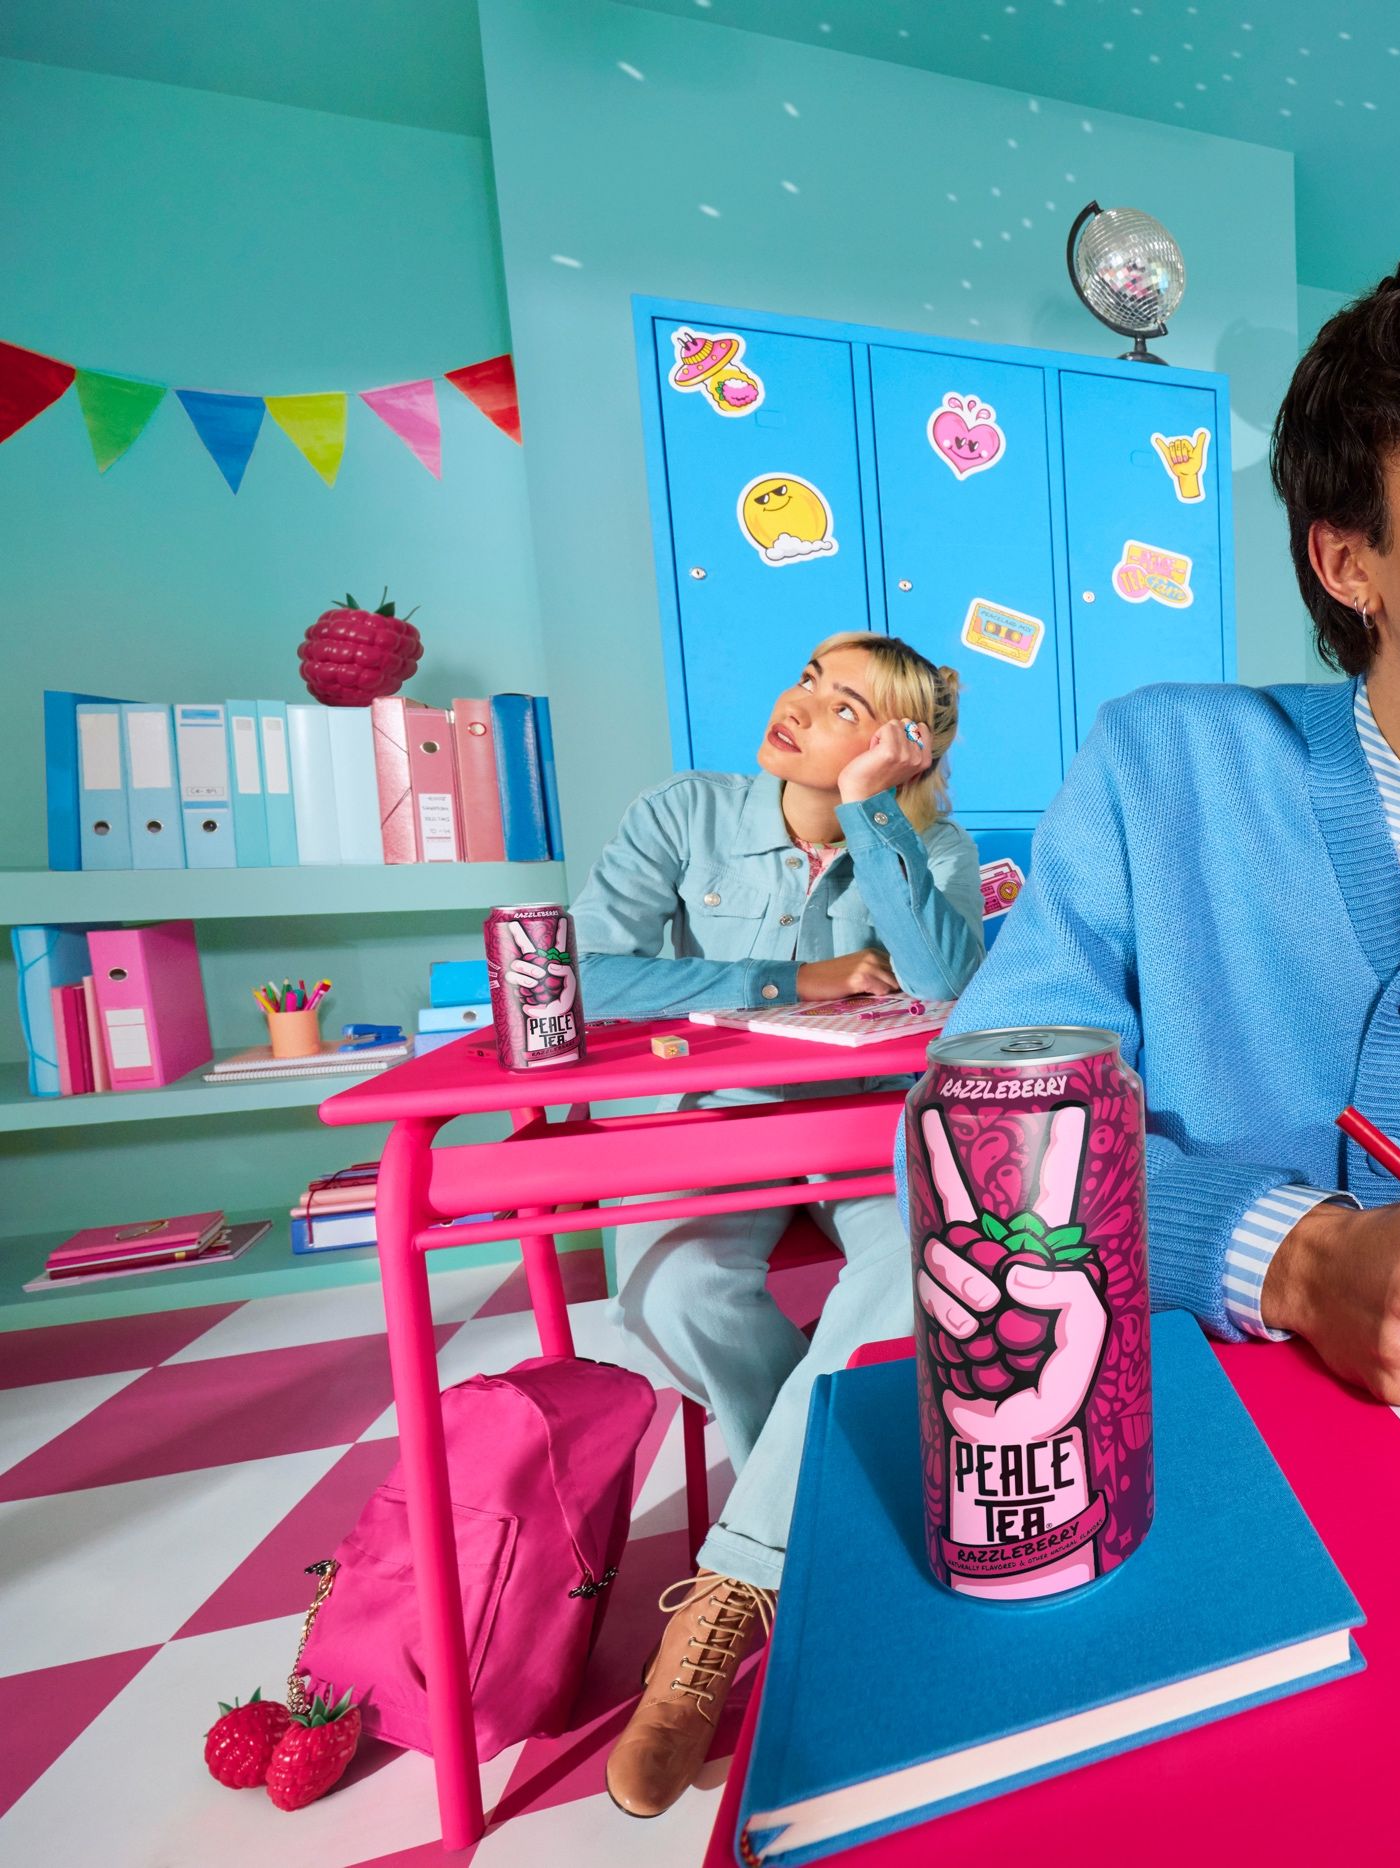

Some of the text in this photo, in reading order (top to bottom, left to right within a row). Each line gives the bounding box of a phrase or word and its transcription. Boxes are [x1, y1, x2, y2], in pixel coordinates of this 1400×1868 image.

[529, 1013, 573, 1035] PEACE
[940, 1075, 1067, 1100] RAZZLEBERRY
[955, 1434, 1075, 1497] PEACE
[957, 1521, 1079, 1562] RAZZLEBERRY
[981, 1562, 1016, 1571] FLAVORED
[1027, 1553, 1047, 1564] OTHER
[1050, 1539, 1077, 1555] NATURAL
